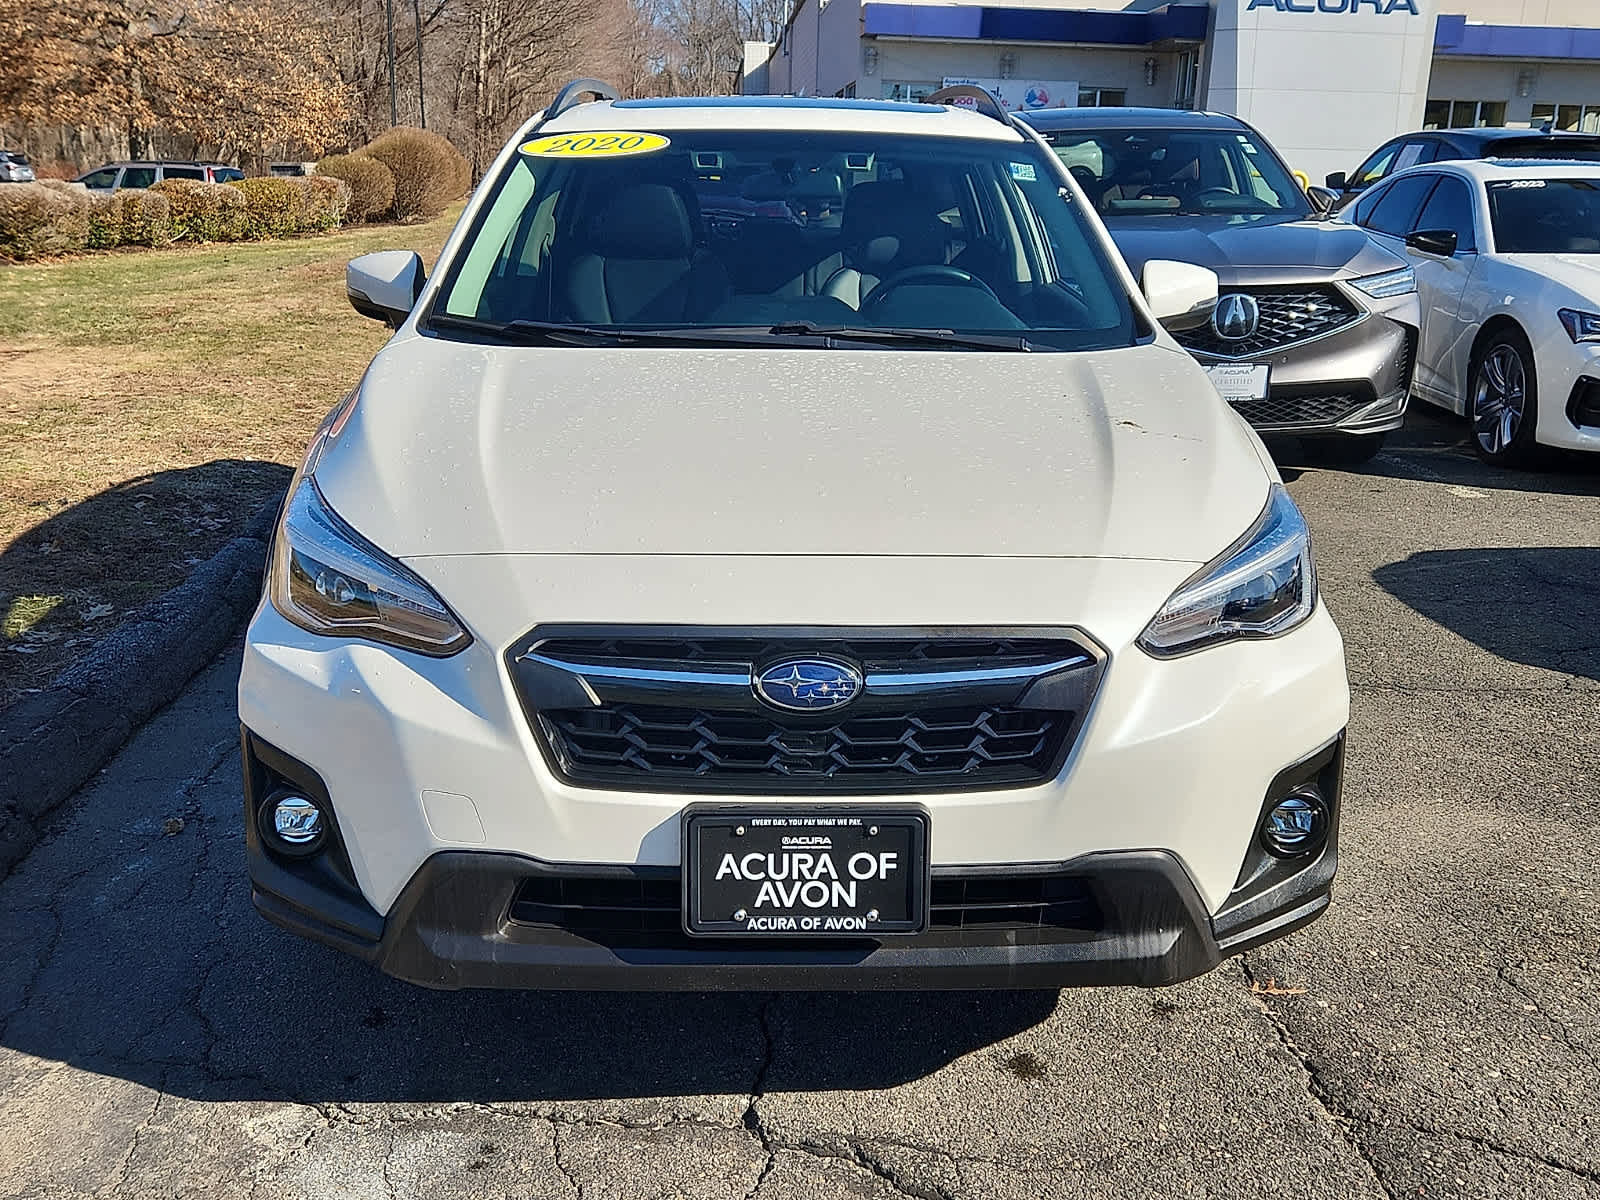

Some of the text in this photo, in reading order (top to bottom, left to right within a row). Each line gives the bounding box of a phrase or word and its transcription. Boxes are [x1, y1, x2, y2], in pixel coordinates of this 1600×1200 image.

[1246, 0, 1419, 15] ACURA
[544, 136, 645, 153] 2020
[752, 818, 863, 827] EVERY DAY, YOU PAY WHAT WE PAY.
[790, 837, 832, 845] ACURA
[715, 851, 898, 881] ACURA OF
[754, 880, 857, 908] AVON
[747, 917, 867, 930] ACURA OF AVON
